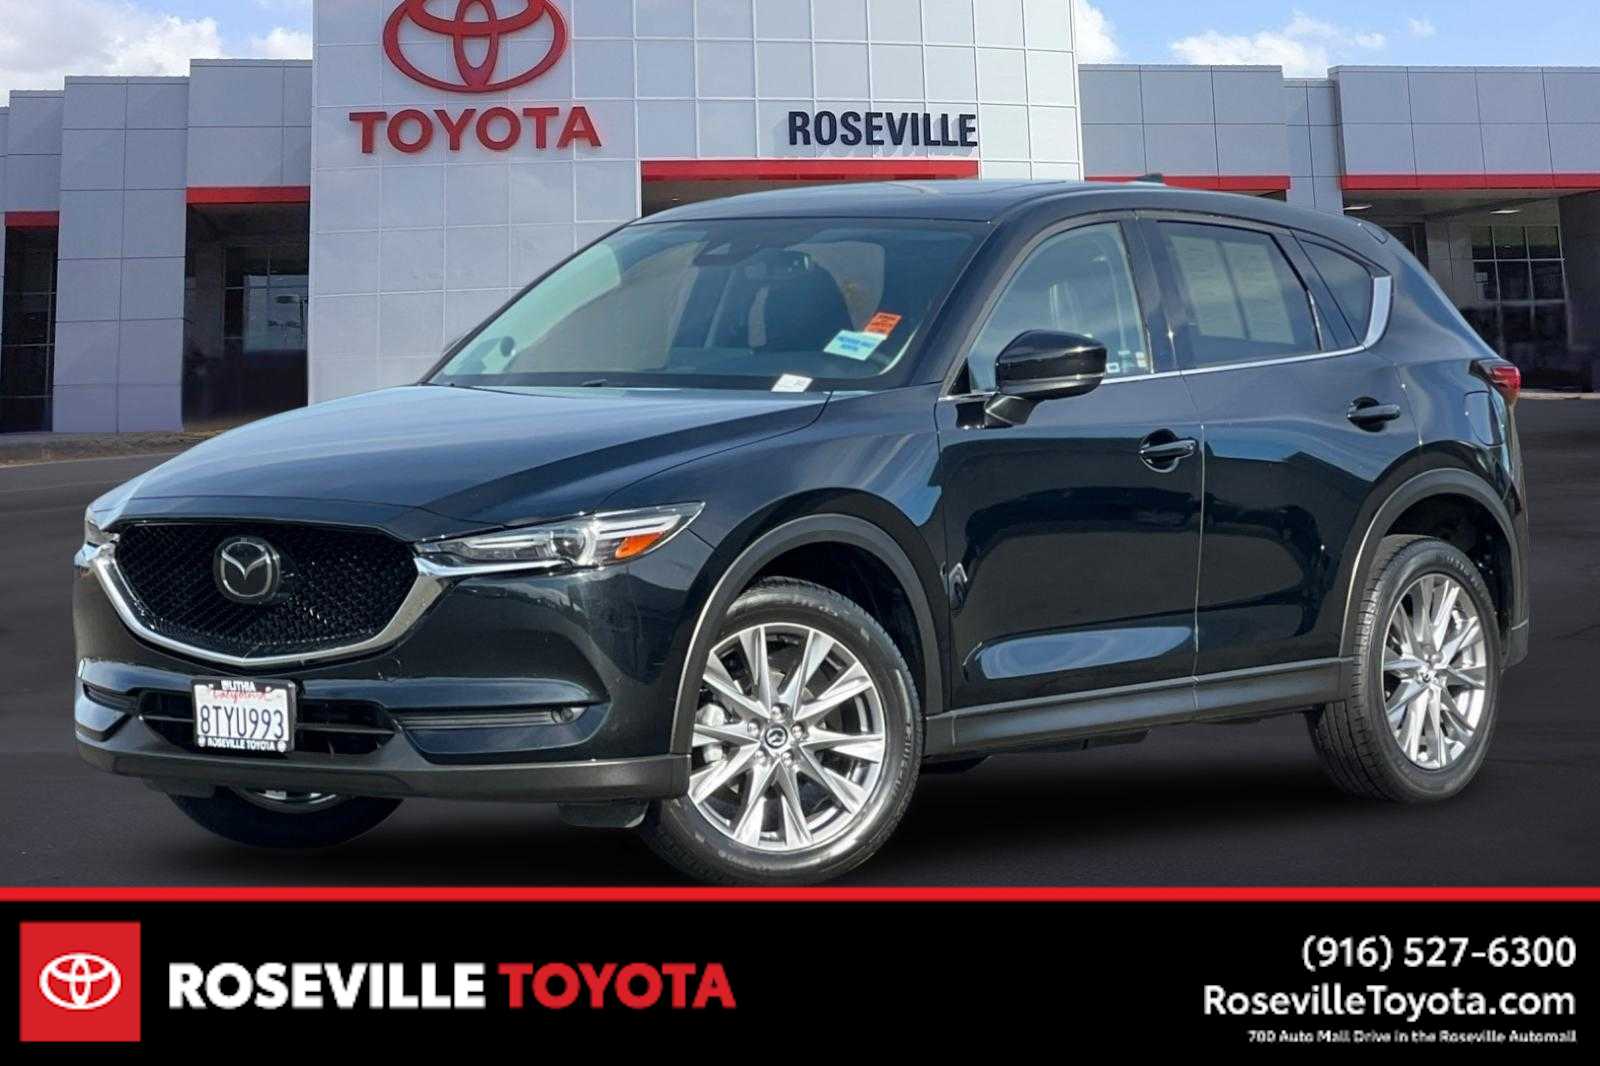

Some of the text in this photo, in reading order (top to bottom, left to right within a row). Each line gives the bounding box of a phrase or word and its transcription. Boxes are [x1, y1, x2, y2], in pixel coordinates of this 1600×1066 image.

[350, 106, 602, 153] TOYOTA
[788, 111, 978, 147] ROSEVILLE
[201, 705, 284, 739] 8TYU993
[207, 737, 276, 751] ROSEVILLE TOYOTA
